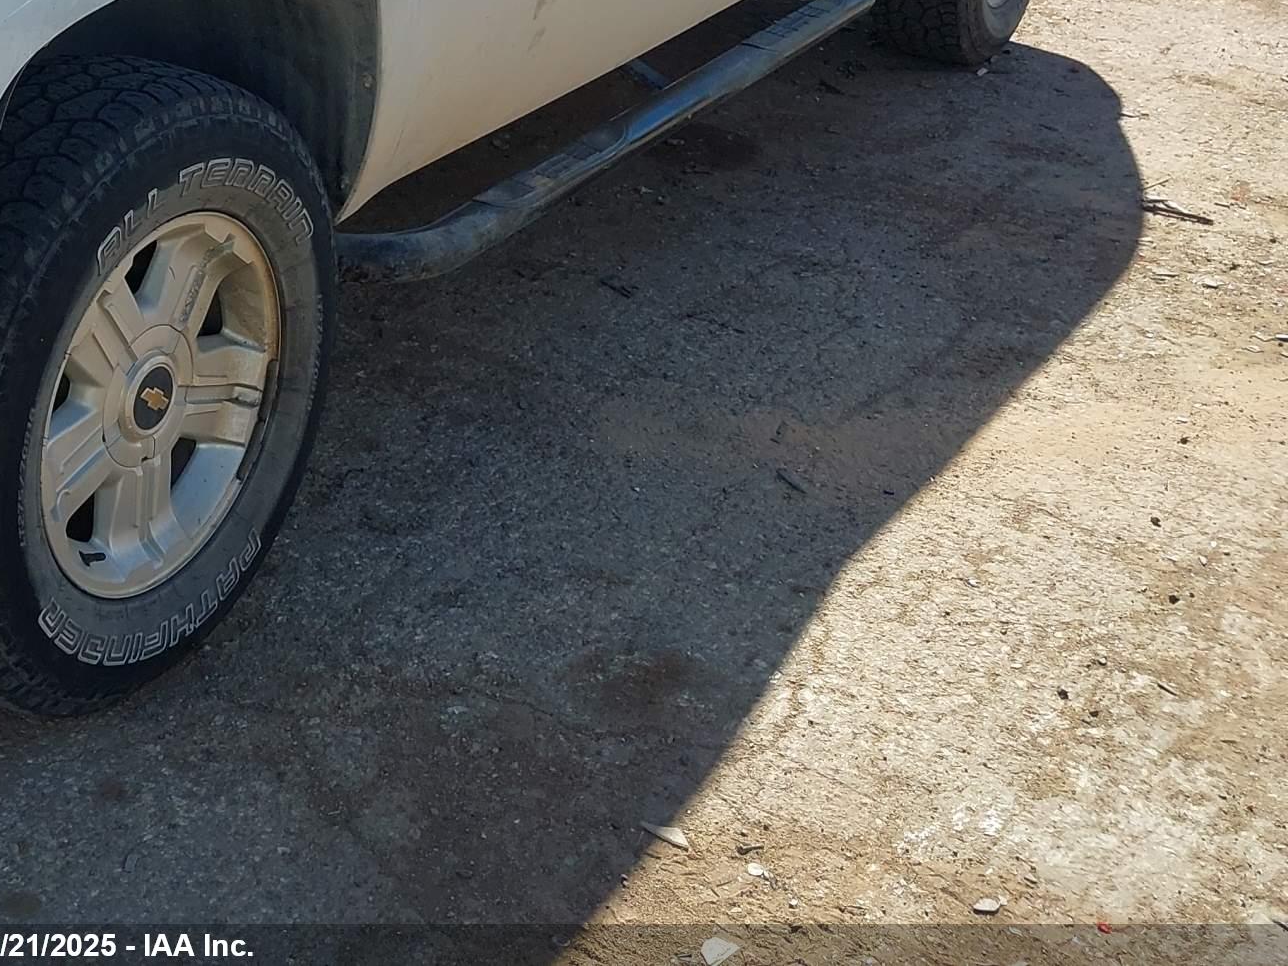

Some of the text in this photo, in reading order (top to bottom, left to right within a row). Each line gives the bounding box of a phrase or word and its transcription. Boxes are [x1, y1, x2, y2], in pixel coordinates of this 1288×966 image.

[96, 157, 315, 277] ALL TERRAIN
[37, 528, 263, 667] PATHFINDER
